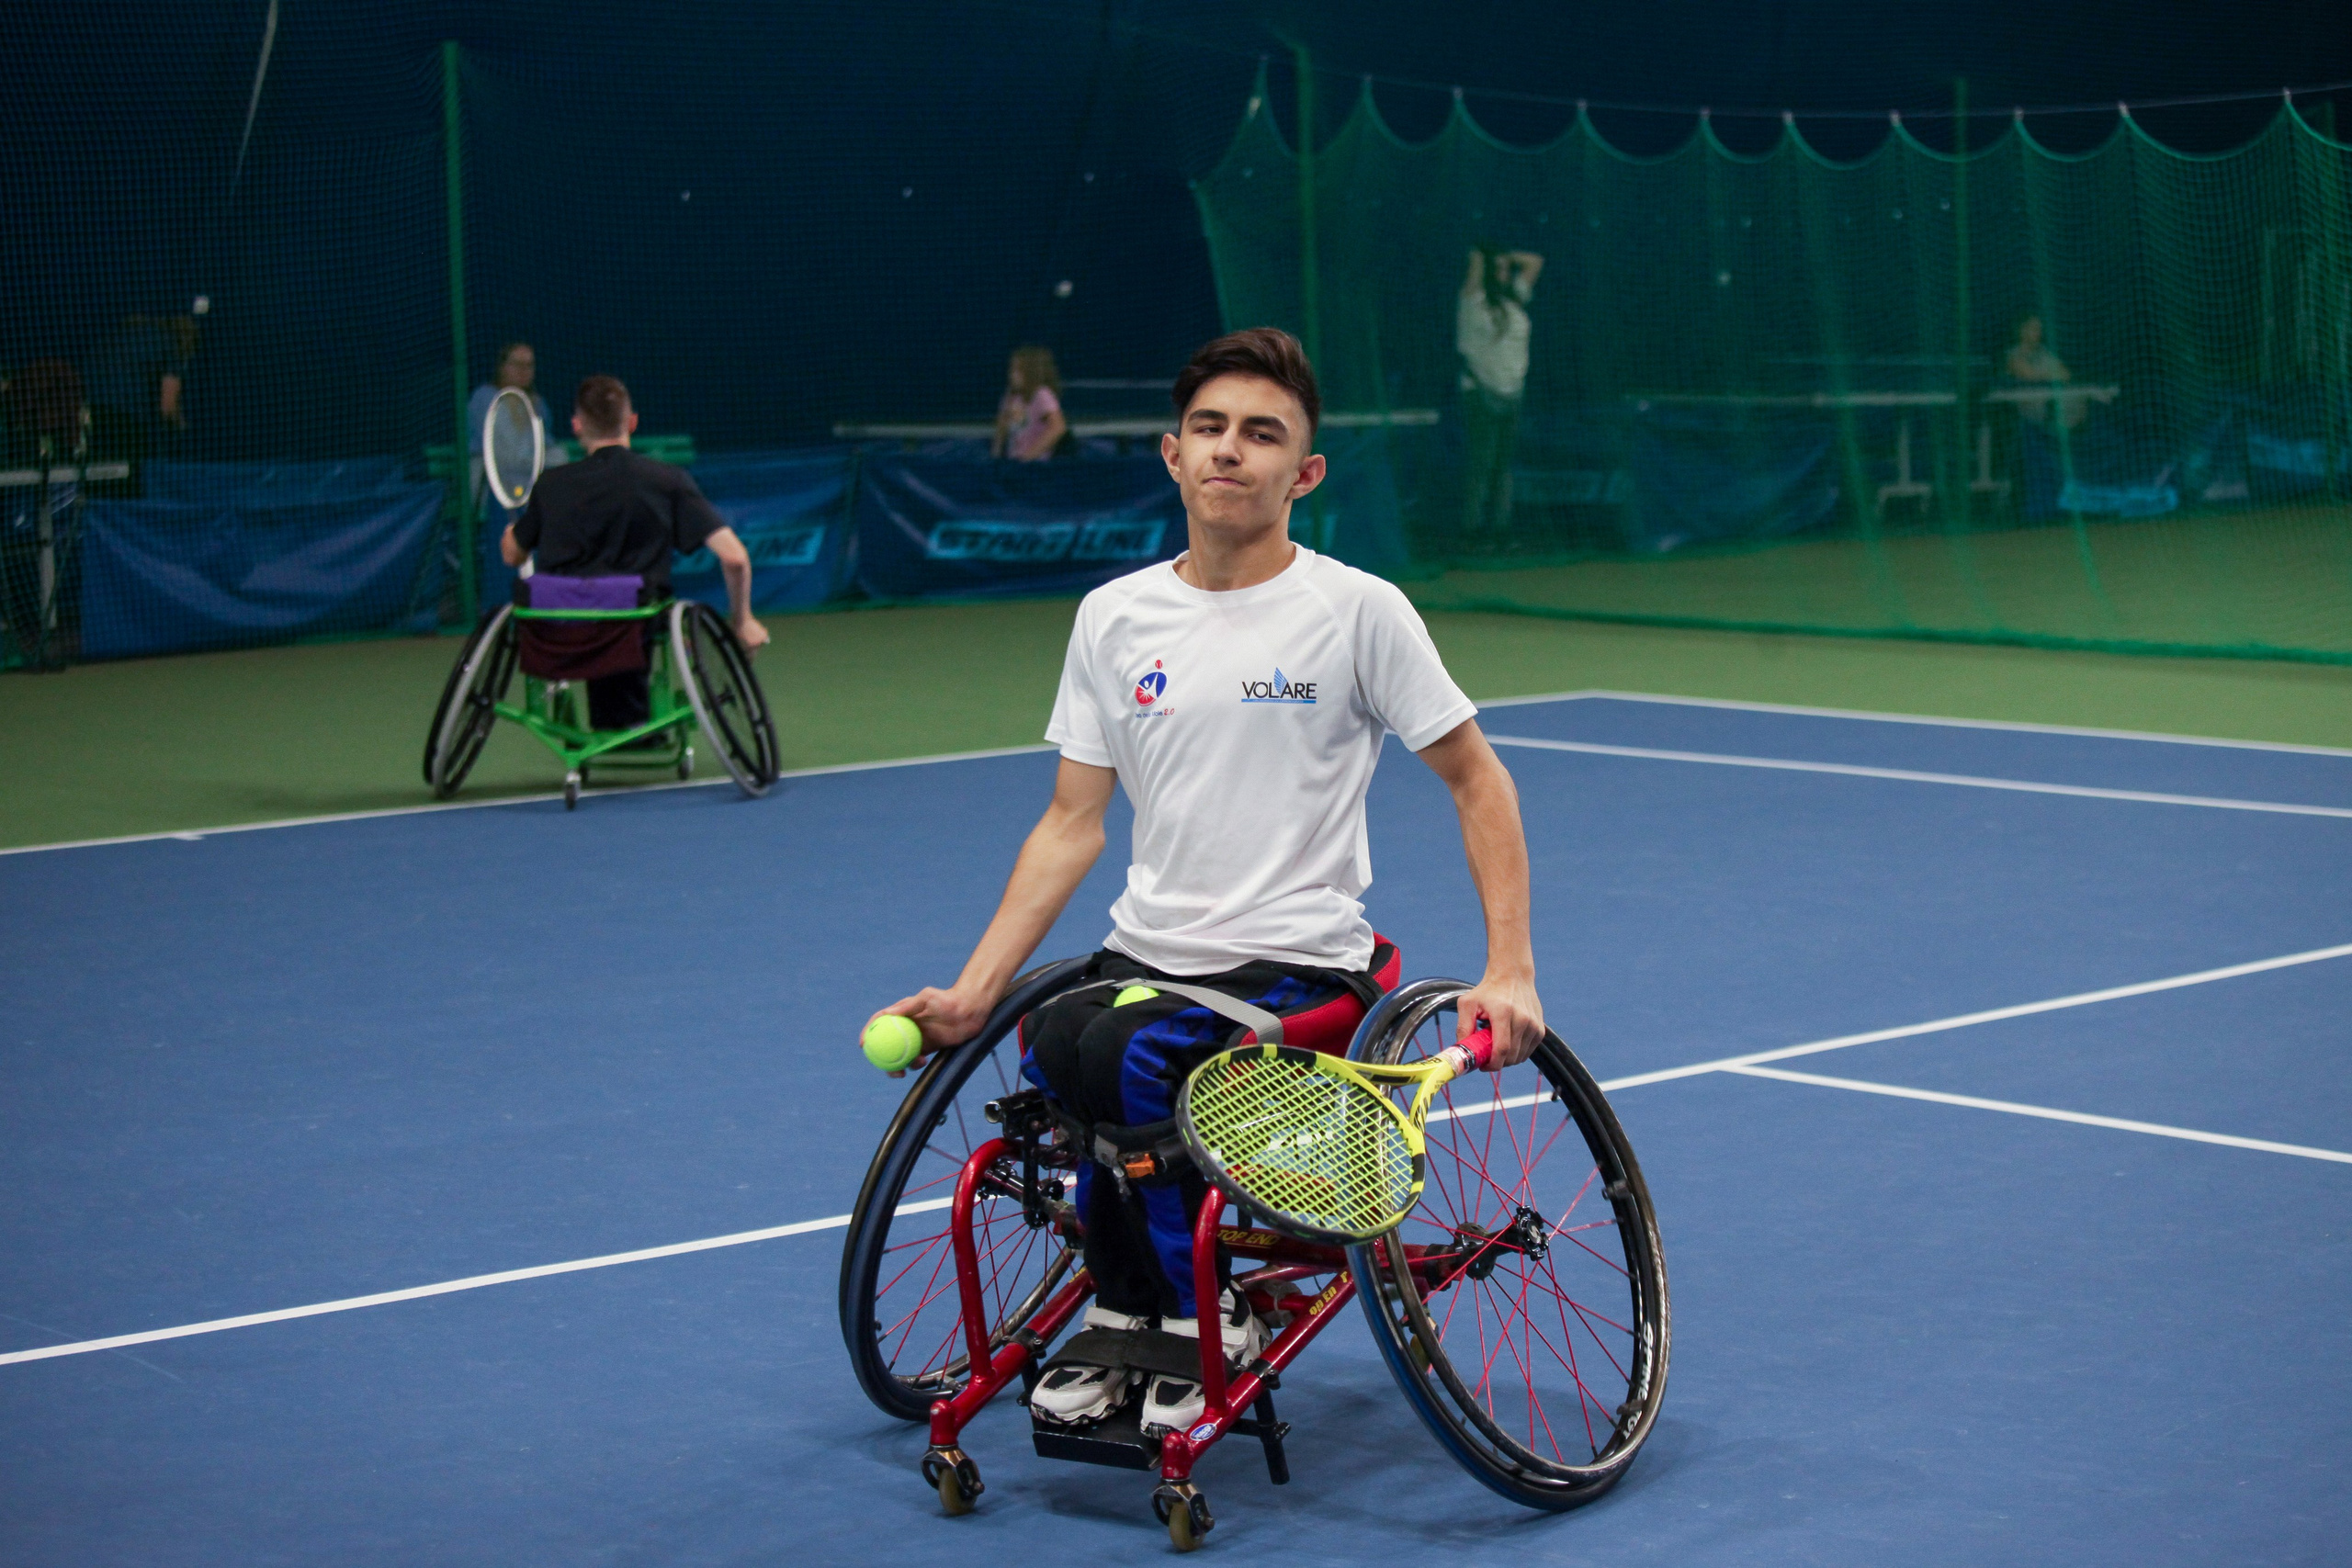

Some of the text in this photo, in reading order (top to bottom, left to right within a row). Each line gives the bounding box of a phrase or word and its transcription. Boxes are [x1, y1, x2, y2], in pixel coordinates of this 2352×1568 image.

[1241, 681, 1317, 700] VOLARE
[1216, 1229, 1282, 1246] TOP END
